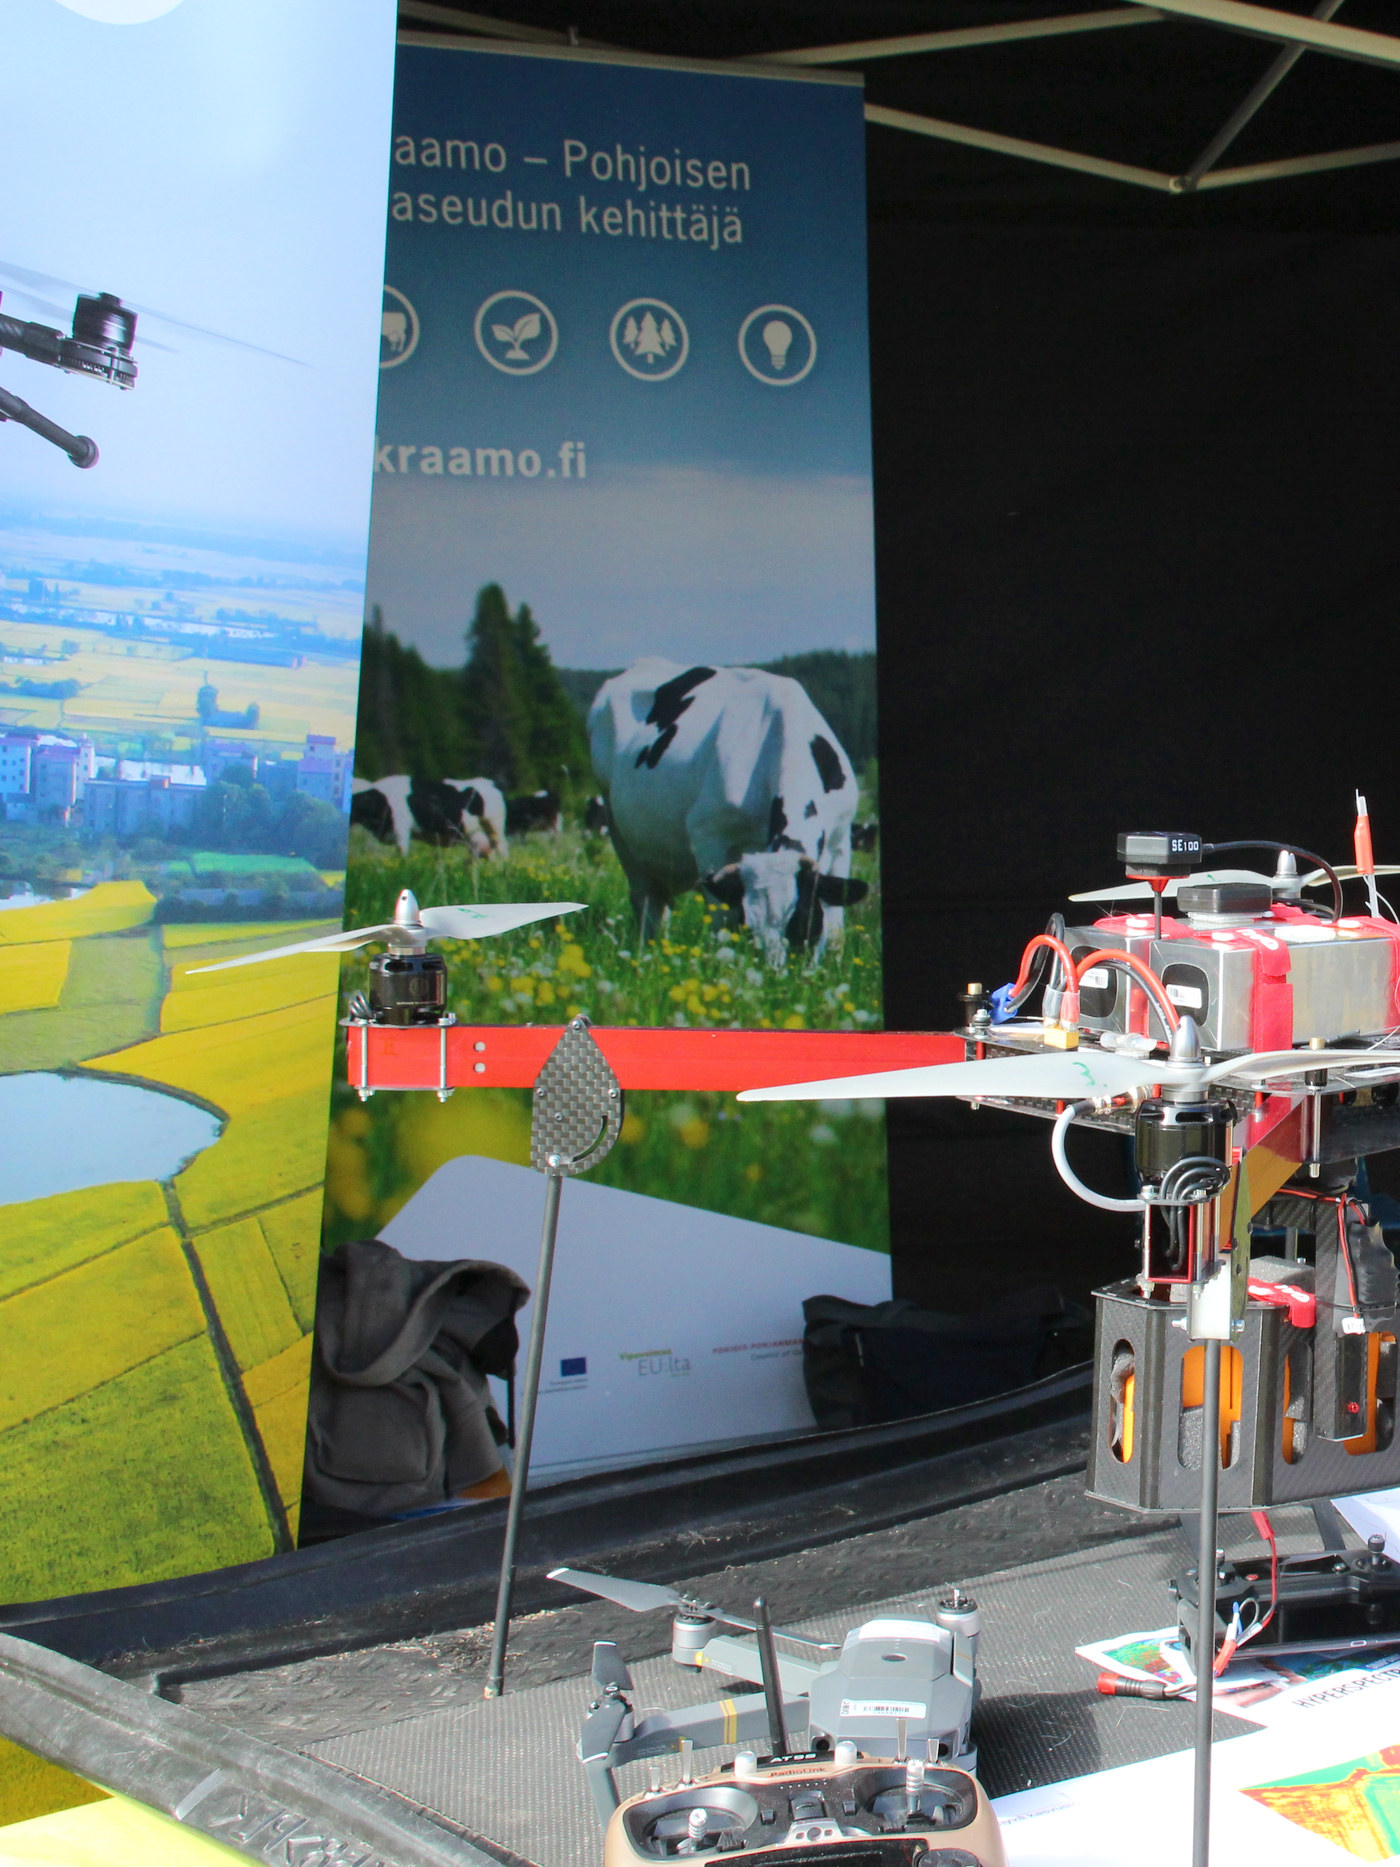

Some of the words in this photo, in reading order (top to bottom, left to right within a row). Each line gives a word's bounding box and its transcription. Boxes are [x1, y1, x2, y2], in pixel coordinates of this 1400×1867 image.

[394, 135, 507, 172] aamo
[563, 139, 750, 191] Pohjoisen
[392, 190, 561, 232] aseudun
[579, 195, 742, 250] kehittäjä
[374, 434, 587, 478] kraamo.fi
[1171, 839, 1199, 852] SE100
